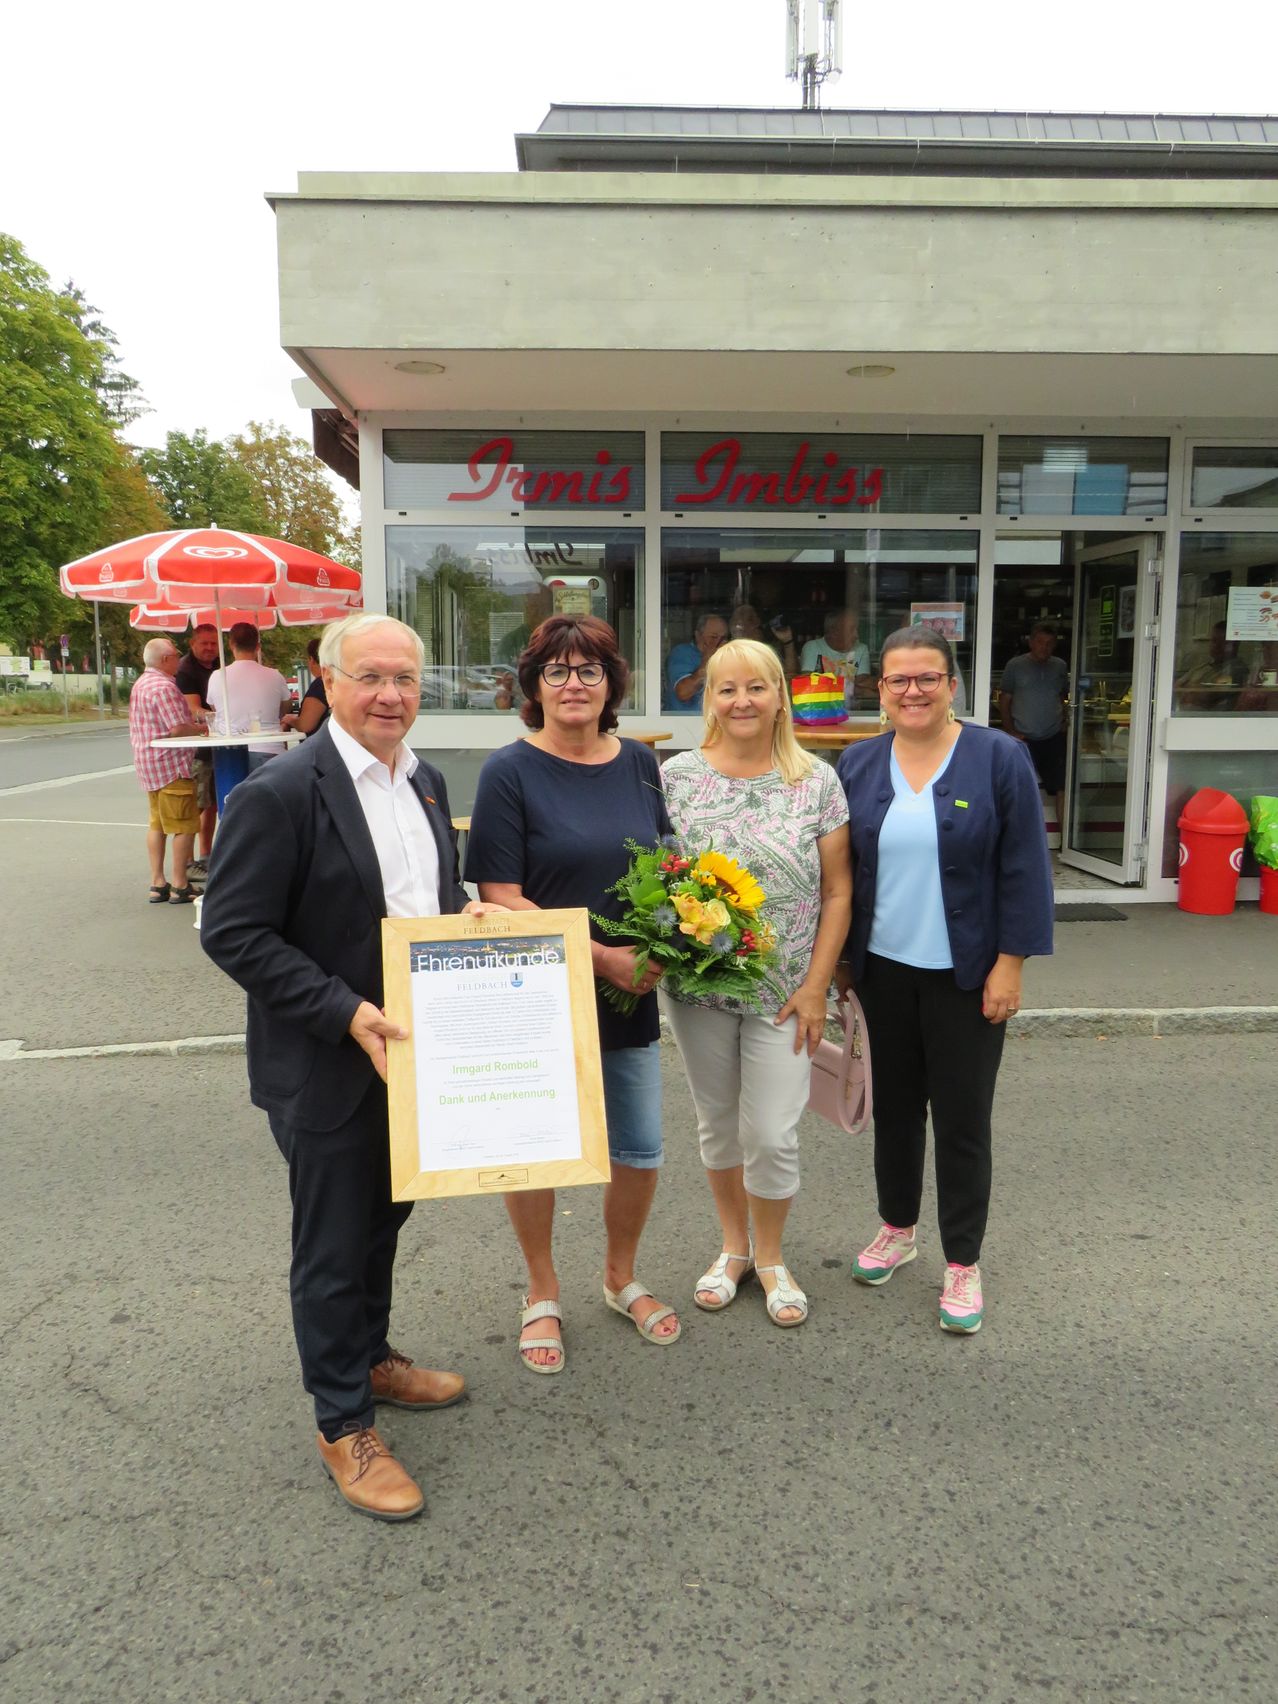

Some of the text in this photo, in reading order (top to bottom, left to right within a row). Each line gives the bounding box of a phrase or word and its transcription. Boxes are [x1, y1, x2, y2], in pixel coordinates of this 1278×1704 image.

[448, 437, 884, 504] Irmis Imbiss
[463, 926, 511, 934] FELDBACH
[417, 947, 559, 972] Ehrenurkunde
[457, 981, 508, 991] FELDBACH
[452, 1059, 538, 1076] Irmgard Rombold
[439, 1088, 555, 1106] Dank und Anerkennung
